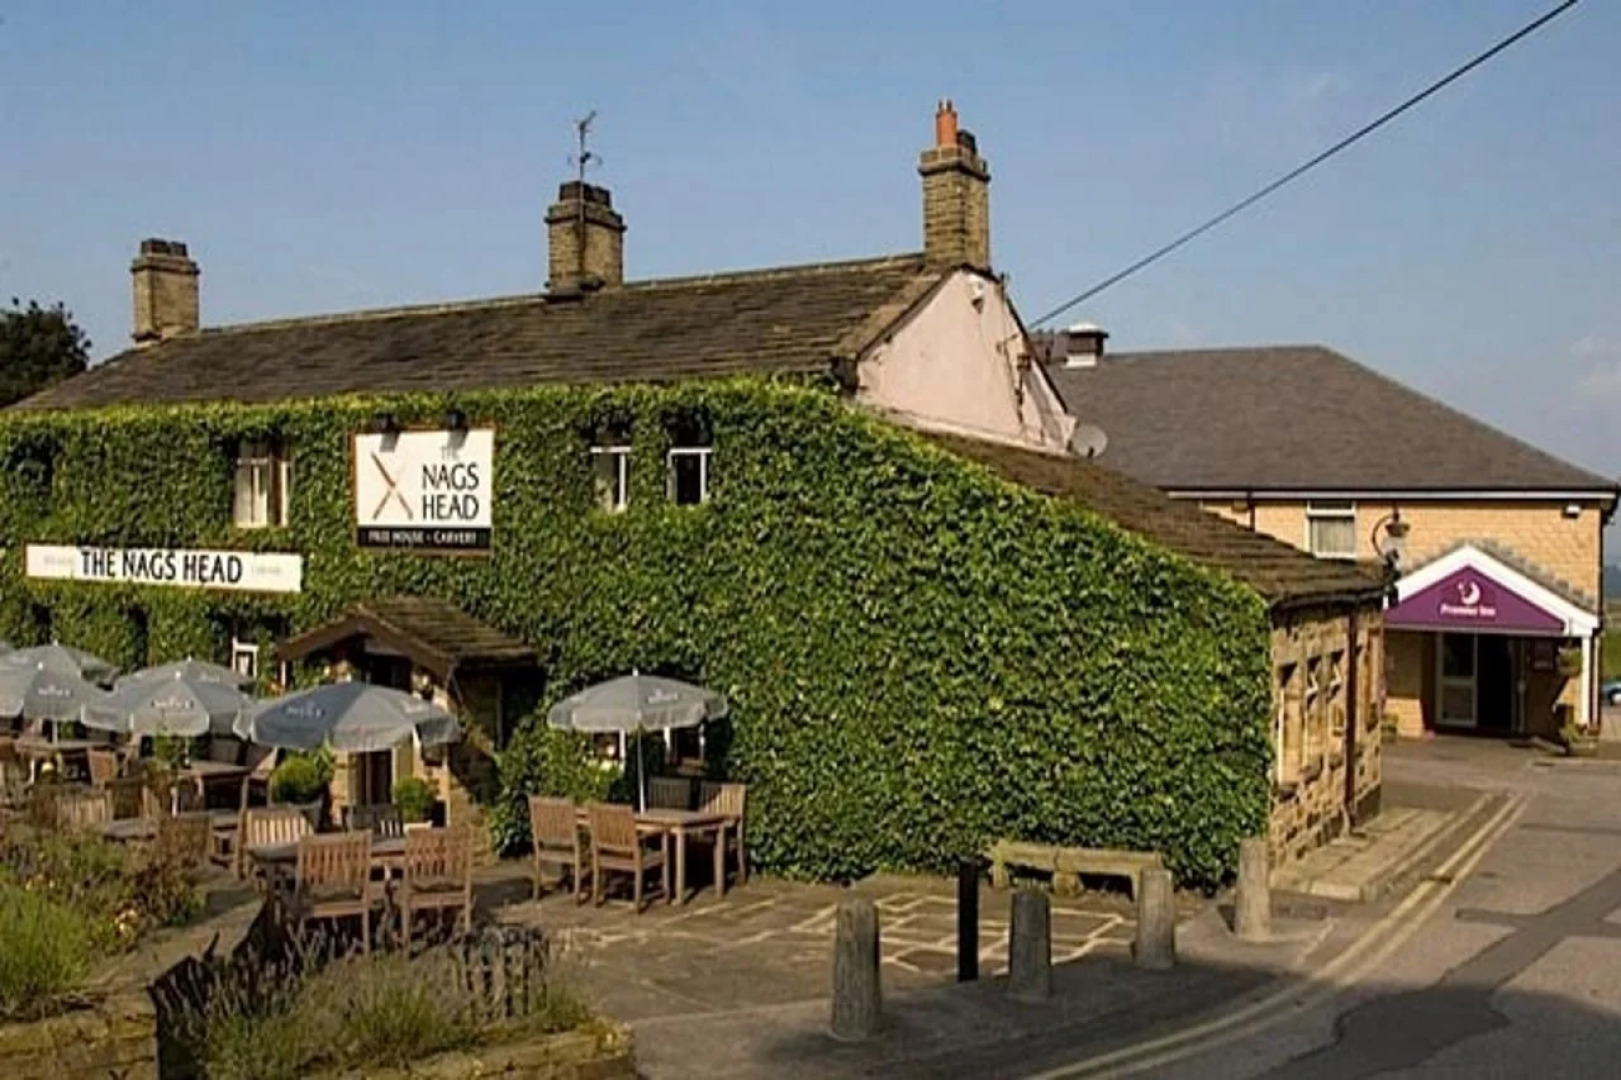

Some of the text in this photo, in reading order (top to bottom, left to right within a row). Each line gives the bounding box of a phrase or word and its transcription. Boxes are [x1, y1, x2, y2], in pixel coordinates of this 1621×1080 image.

[422, 462, 480, 491] NAGS
[422, 494, 480, 520] HEAD
[81, 551, 116, 577] THE
[123, 551, 175, 580] NAGS
[183, 554, 243, 583] HEAD
